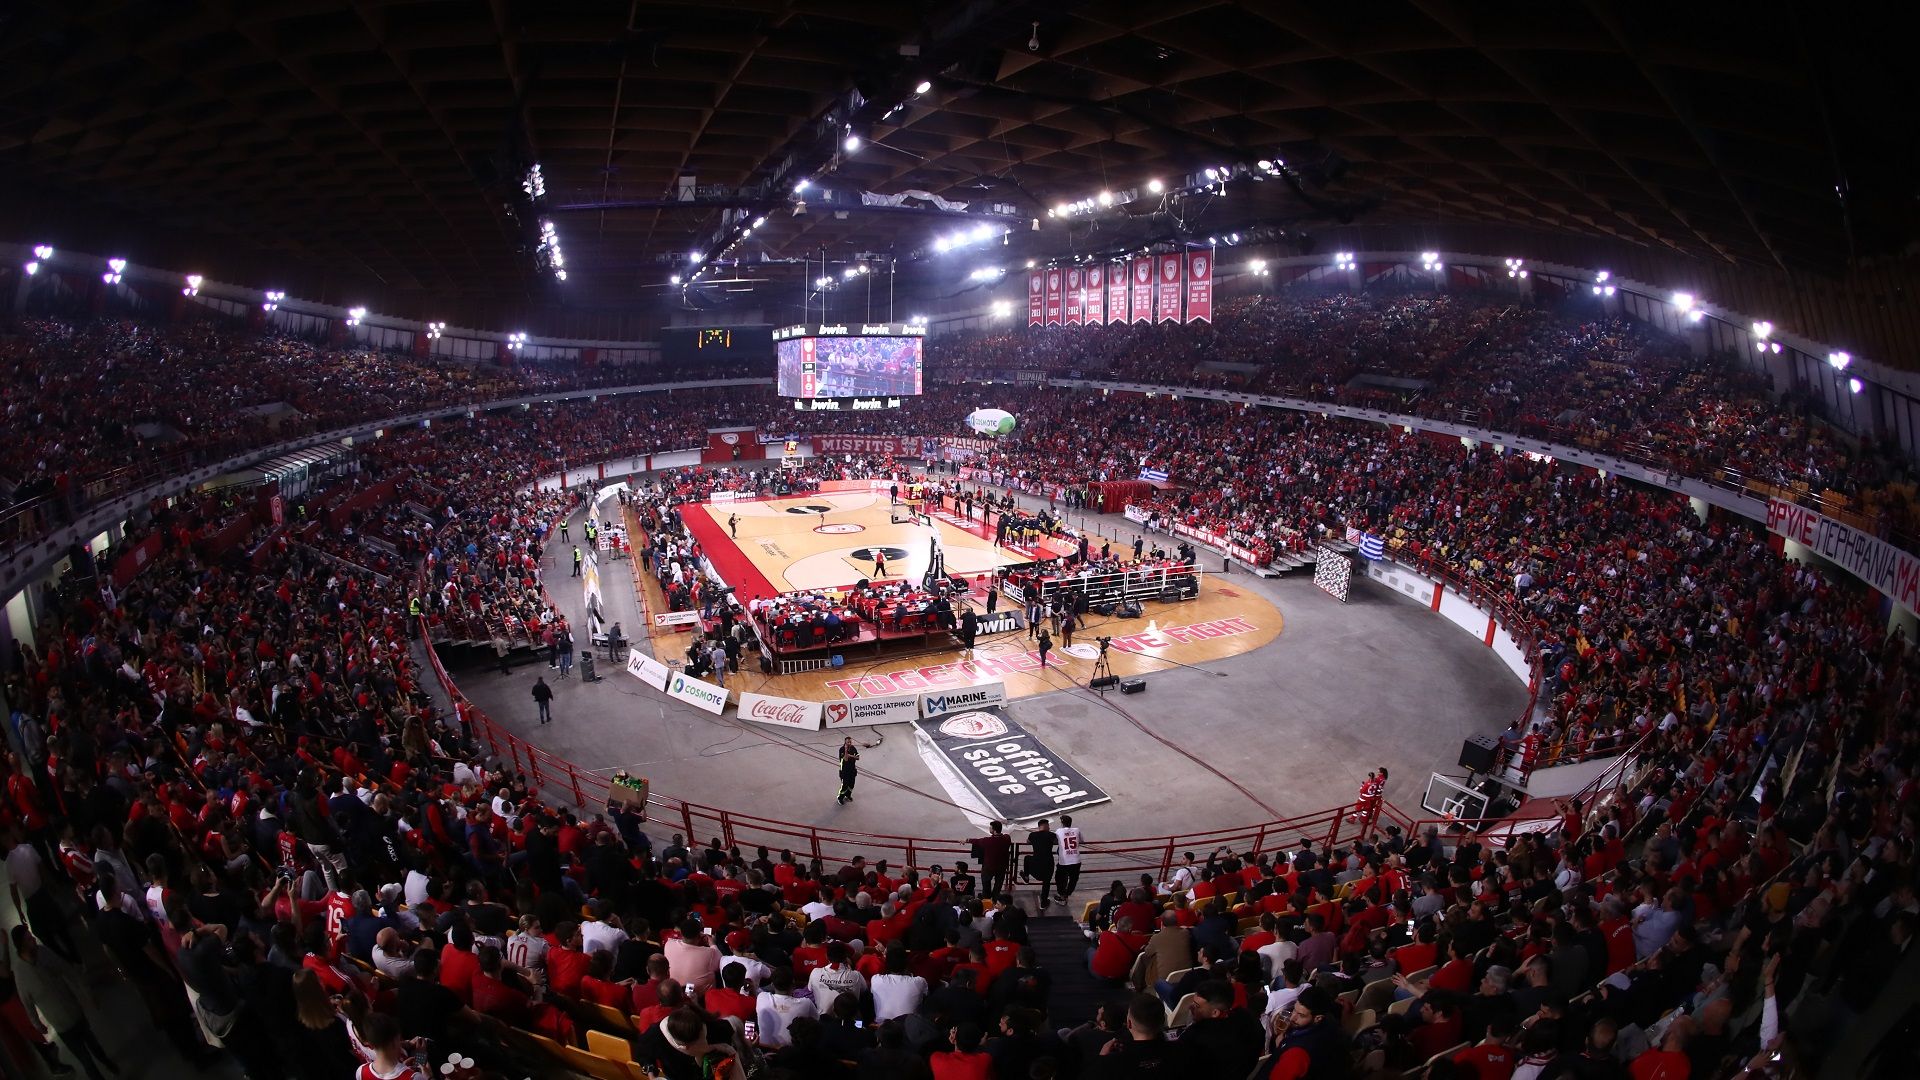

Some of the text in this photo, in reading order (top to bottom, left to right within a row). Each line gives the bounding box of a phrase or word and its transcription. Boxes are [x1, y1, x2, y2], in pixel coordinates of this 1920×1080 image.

[821, 439, 895, 451] MISFITS
[734, 490, 756, 499] bwin
[911, 491, 922, 499] 24
[826, 616, 1260, 699] TOGETHER WE FIGHT
[946, 691, 987, 706] MARINE
[751, 699, 808, 724] Coca-Cola
[853, 700, 916, 713] ΟΜΙΛΟΣ ΙΑΤΡΙΚΟΥ
[854, 709, 887, 719] ΑΘΗΝΩΝ
[963, 748, 1027, 796] store
[995, 742, 1089, 805] official
[1063, 836, 1077, 850] 15
[1399, 874, 1412, 890] 15
[509, 942, 528, 967] 10
